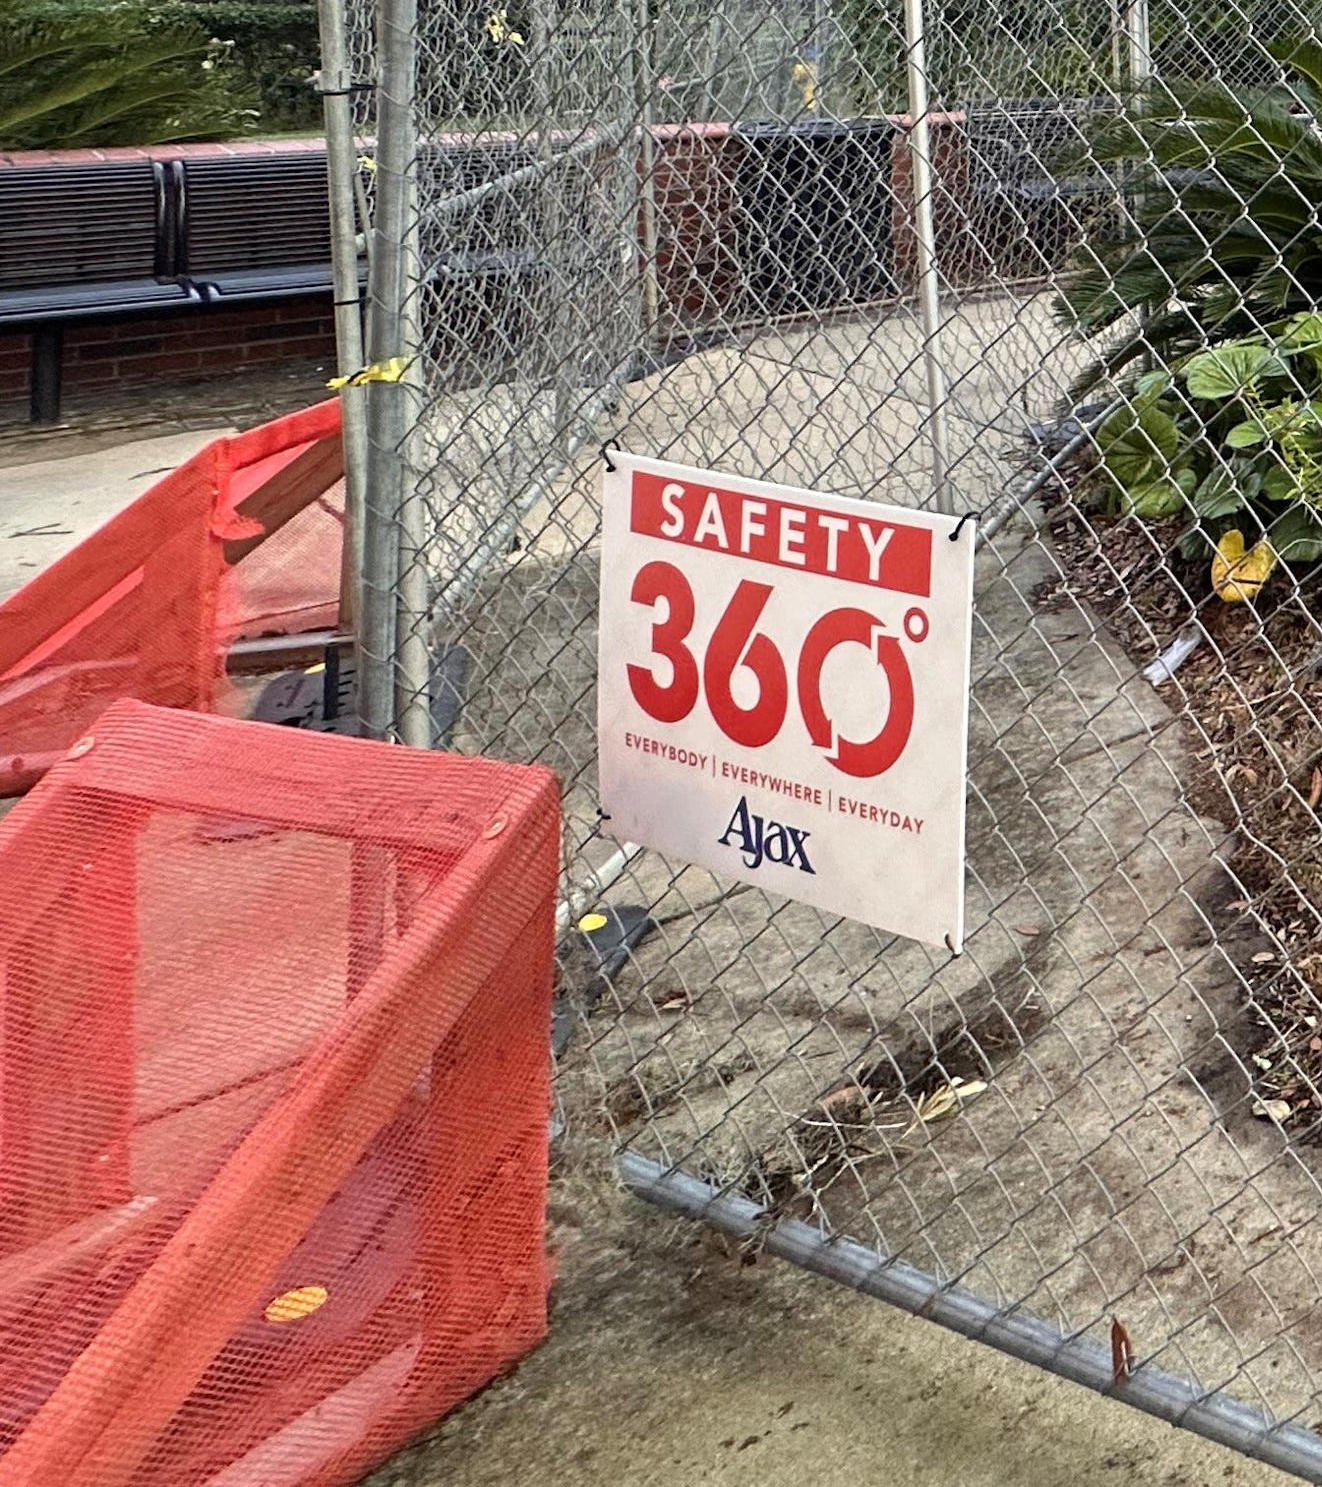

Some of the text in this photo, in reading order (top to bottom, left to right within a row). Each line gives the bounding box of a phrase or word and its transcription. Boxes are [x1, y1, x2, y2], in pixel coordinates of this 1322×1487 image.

[660, 483, 895, 581] SAFETY
[624, 731, 924, 834] EVERYBODY EVERYWHERE EVERYDAY
[717, 795, 817, 875] Ajax
